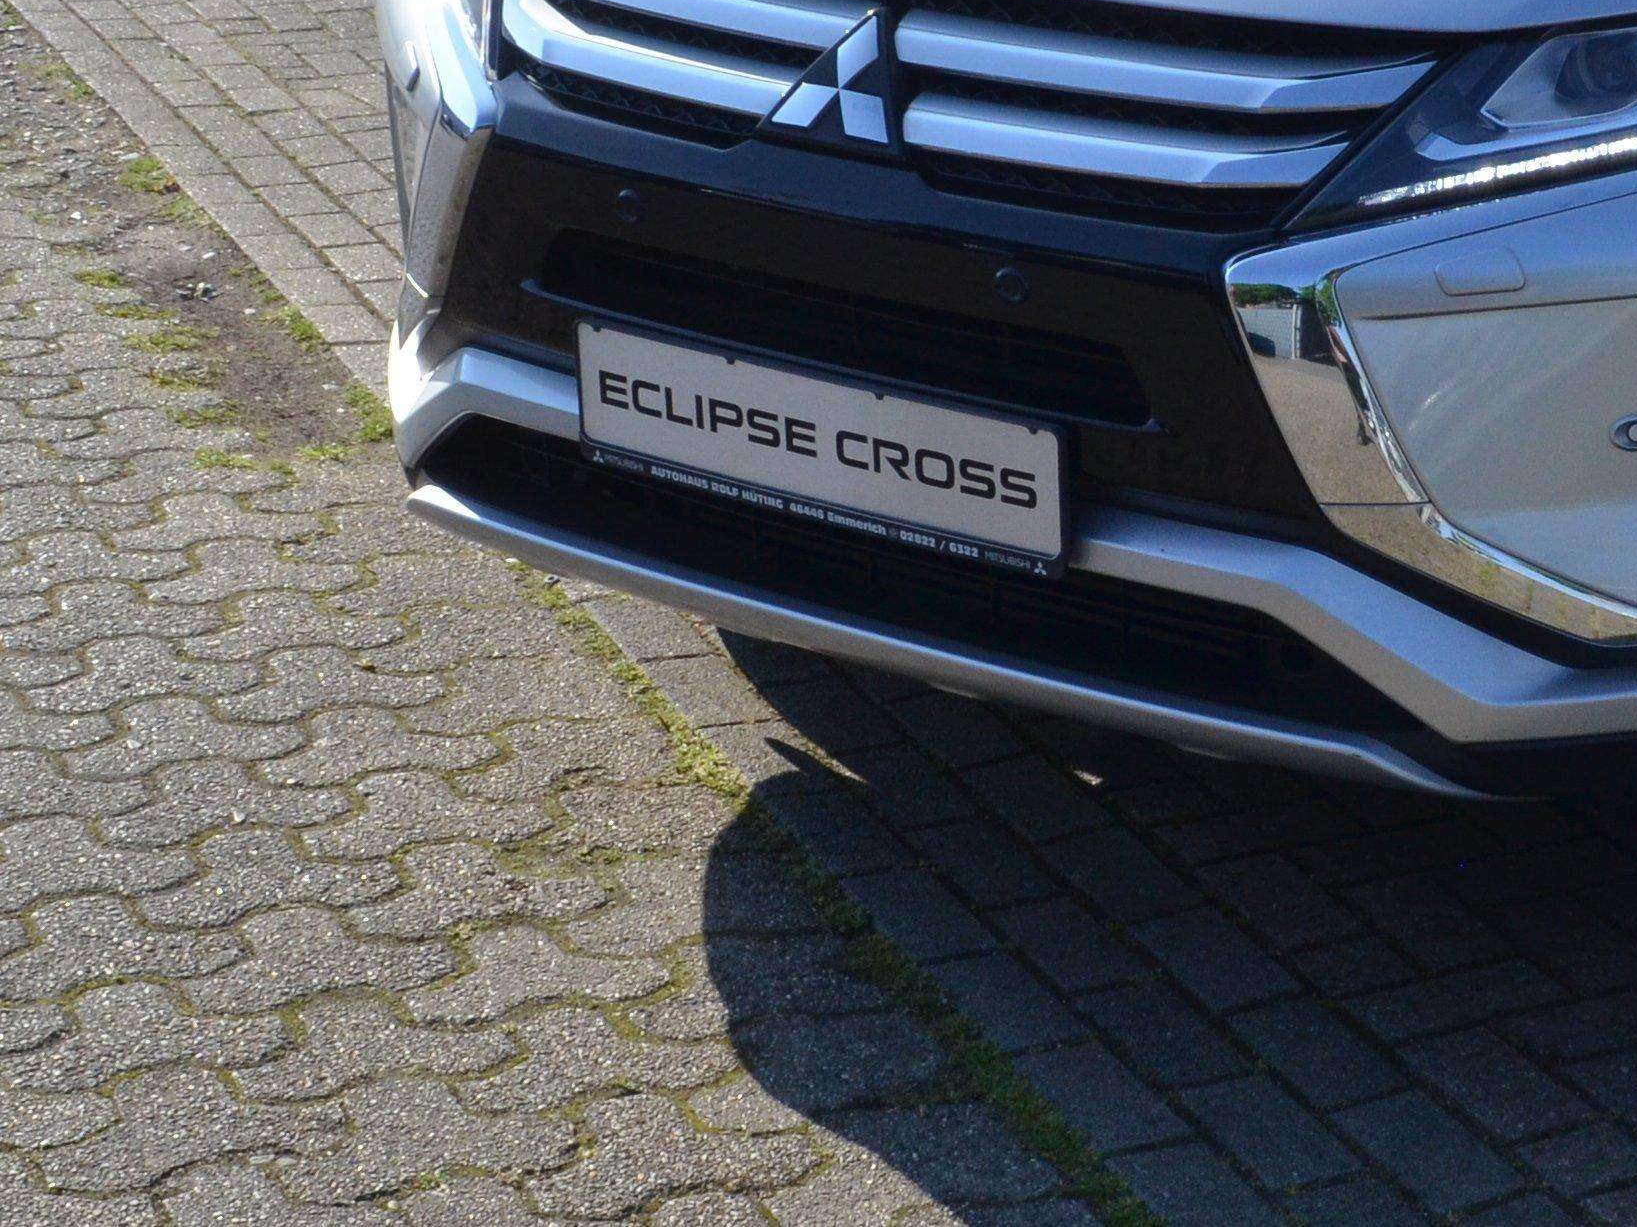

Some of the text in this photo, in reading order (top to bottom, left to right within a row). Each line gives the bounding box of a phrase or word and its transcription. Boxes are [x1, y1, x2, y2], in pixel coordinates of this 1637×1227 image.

[599, 369, 1038, 509] ECLIPSE CROSS
[651, 465, 709, 489] AUTOHAUS
[711, 482, 739, 497] ROLF
[826, 511, 888, 535] Emmerich
[899, 529, 936, 548] 02822
[948, 541, 979, 558] 6322
